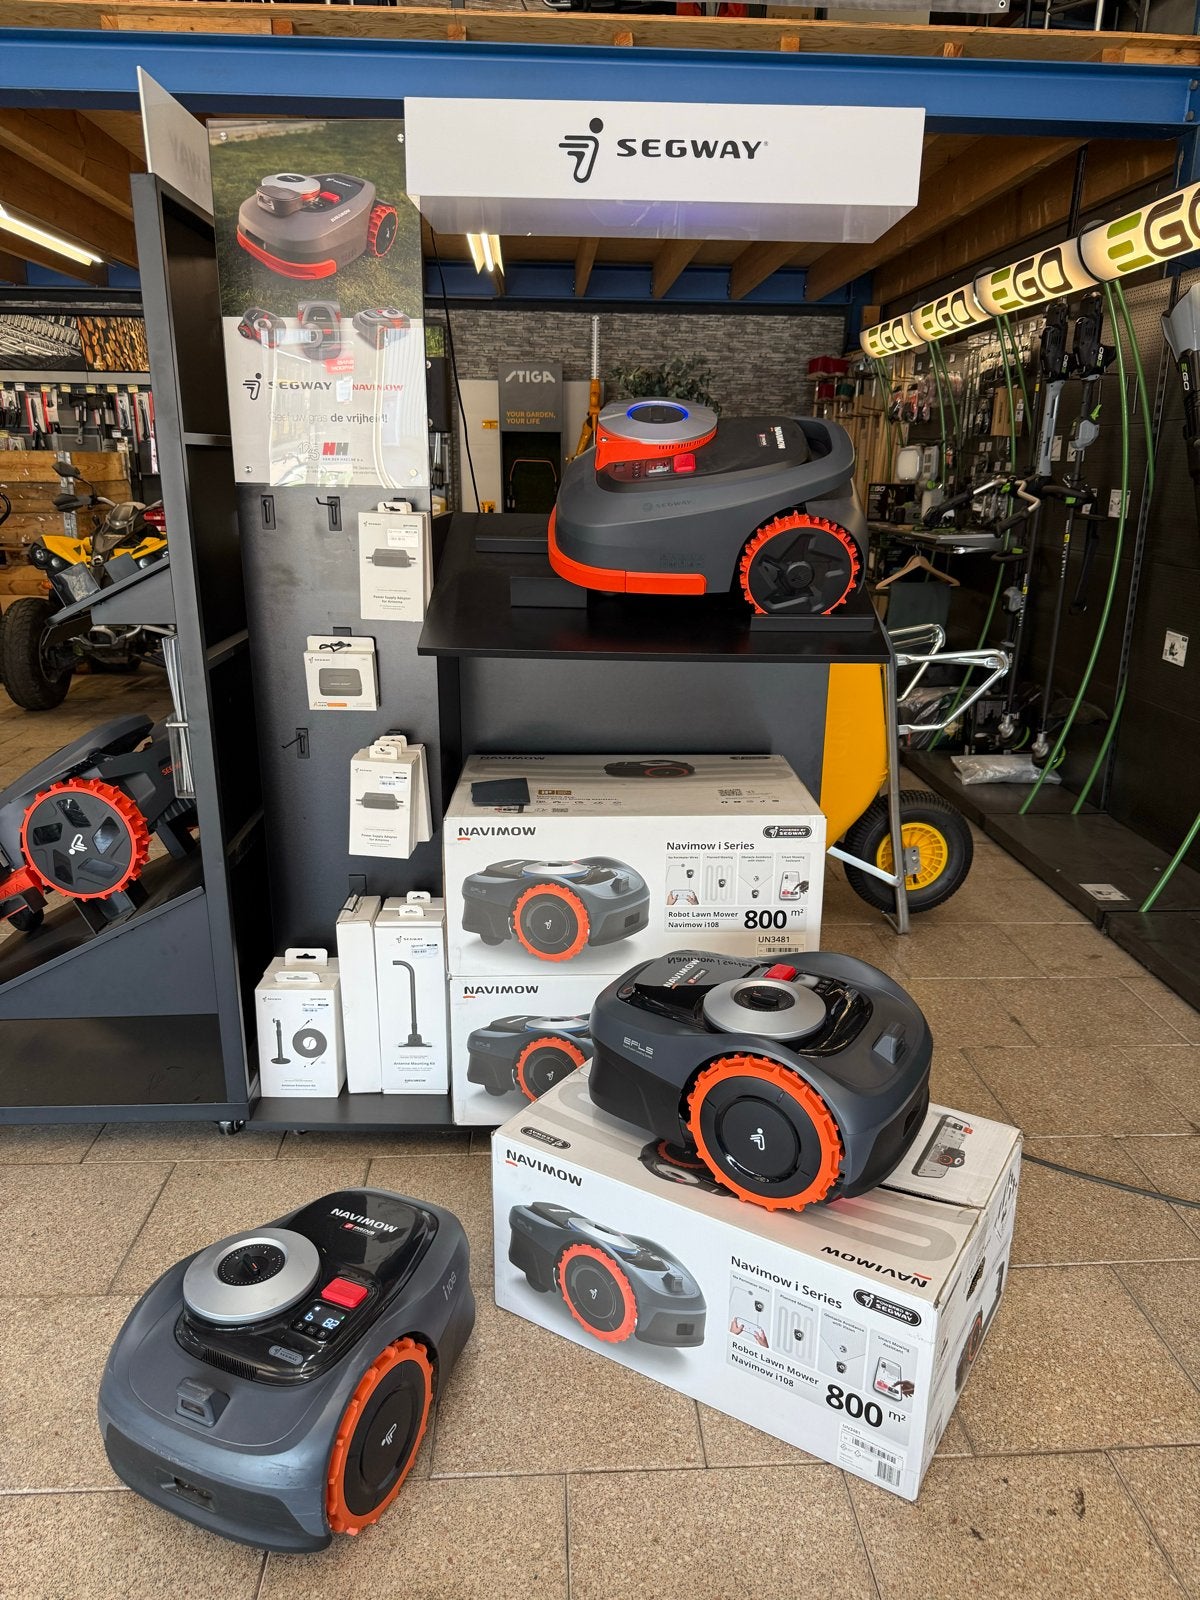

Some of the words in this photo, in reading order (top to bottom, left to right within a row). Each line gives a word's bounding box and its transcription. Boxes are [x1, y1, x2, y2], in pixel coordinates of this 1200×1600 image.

[616, 138, 763, 160] SEGWAY
[1107, 188, 1200, 272] EG
[990, 246, 1073, 311] EGO
[921, 290, 977, 338] EGO
[868, 317, 912, 356] EGO
[268, 381, 332, 391] SEGWAY
[505, 370, 556, 384] STIGA
[1180, 362, 1190, 391] EGO
[308, 415, 328, 425] gras
[330, 413, 344, 423] de
[526, 411, 556, 420] GARDEN,
[458, 826, 536, 837] NAVIMOW
[666, 841, 716, 850] Navimow
[718, 841, 722, 850] i
[724, 841, 755, 850] Series
[744, 909, 787, 930] 800
[758, 935, 790, 944] UN3481
[663, 958, 701, 989] NAVIMOW
[463, 985, 539, 996] NAVIMOW
[505, 1148, 583, 1187] NAVIMOW
[331, 1207, 399, 1234] NAVIMOW
[820, 1246, 928, 1288] NAVIMOW
[730, 1255, 793, 1288] Navimow
[795, 1281, 799, 1292] i
[802, 1283, 843, 1310] Series
[875, 1299, 905, 1313] POWERED
[875, 1303, 913, 1322] SEGWAY
[322, 1317, 340, 1330] 82
[731, 1353, 773, 1380] Navimow
[774, 1370, 795, 1388] i108
[732, 1341, 759, 1362] Robot
[760, 1350, 785, 1372] Lawn
[787, 1361, 819, 1386] Mower
[825, 1383, 884, 1428] 800
